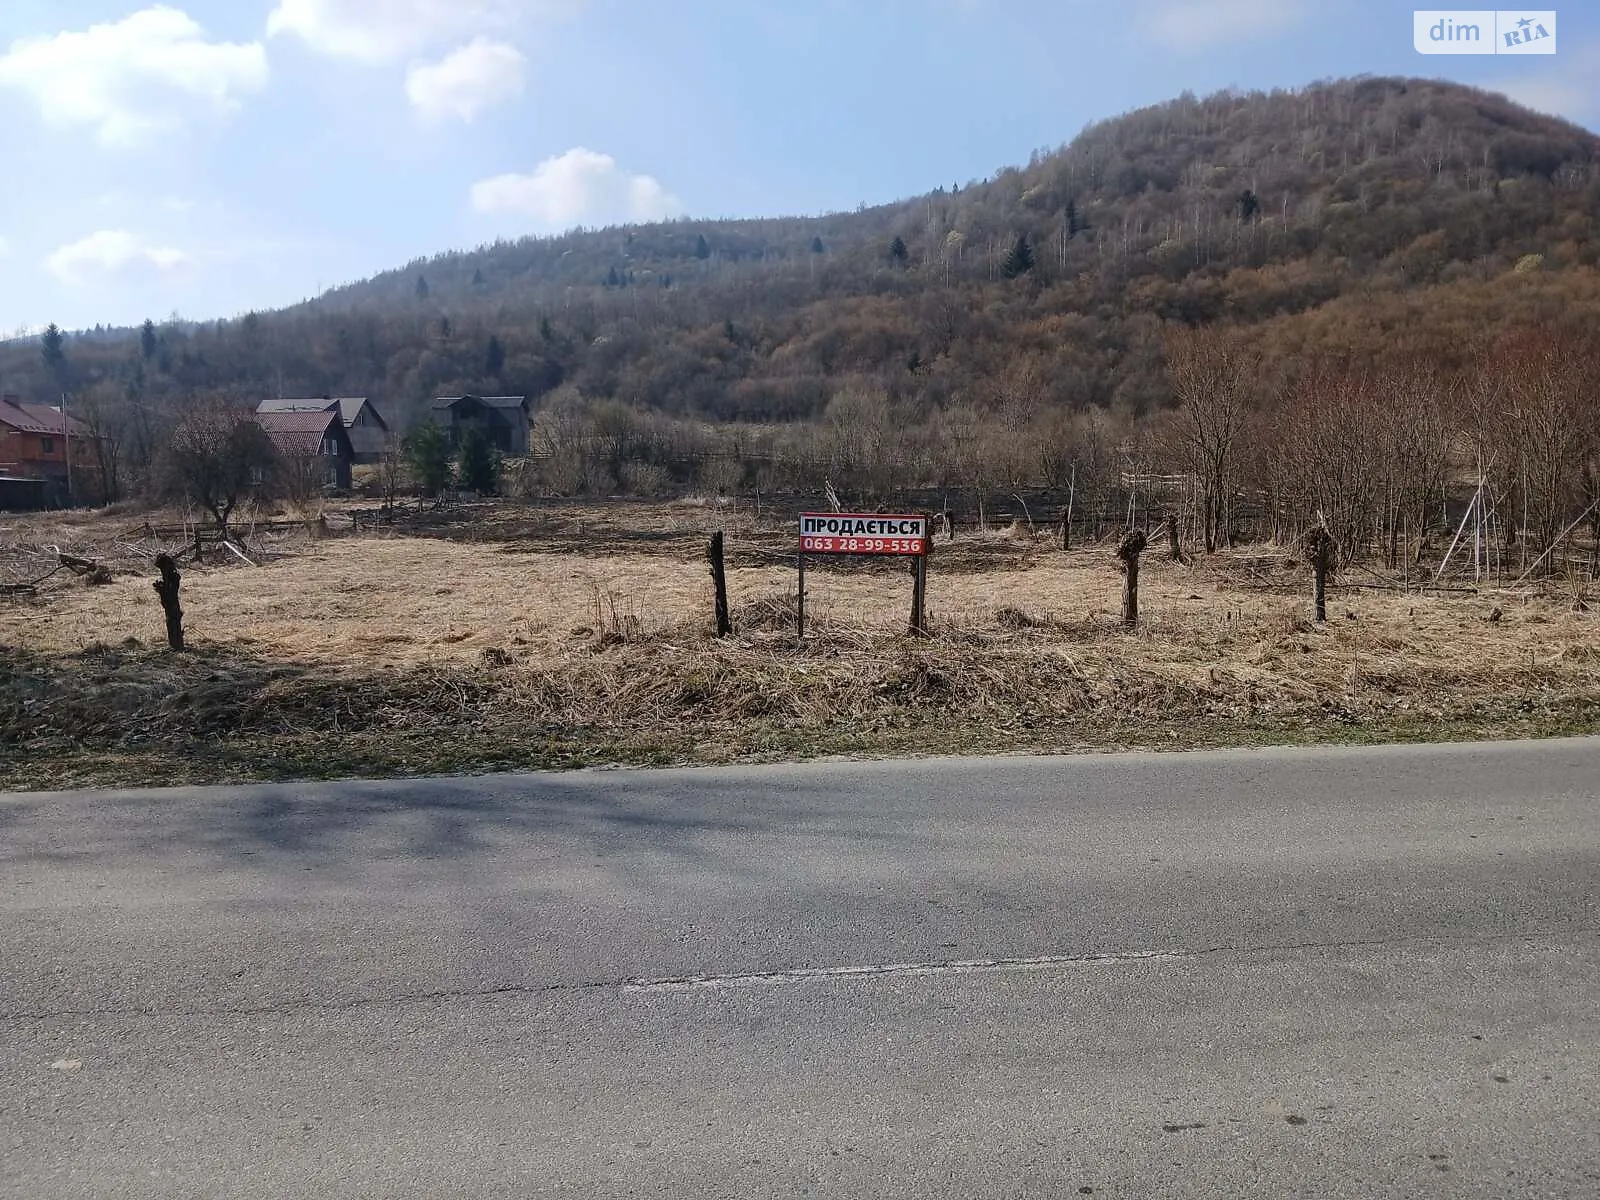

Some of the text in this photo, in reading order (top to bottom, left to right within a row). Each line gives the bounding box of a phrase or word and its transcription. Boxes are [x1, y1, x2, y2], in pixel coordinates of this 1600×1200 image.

[804, 518, 920, 536] ПРОДАЄТЬСЯ
[804, 538, 921, 552] 063 28-99-536
